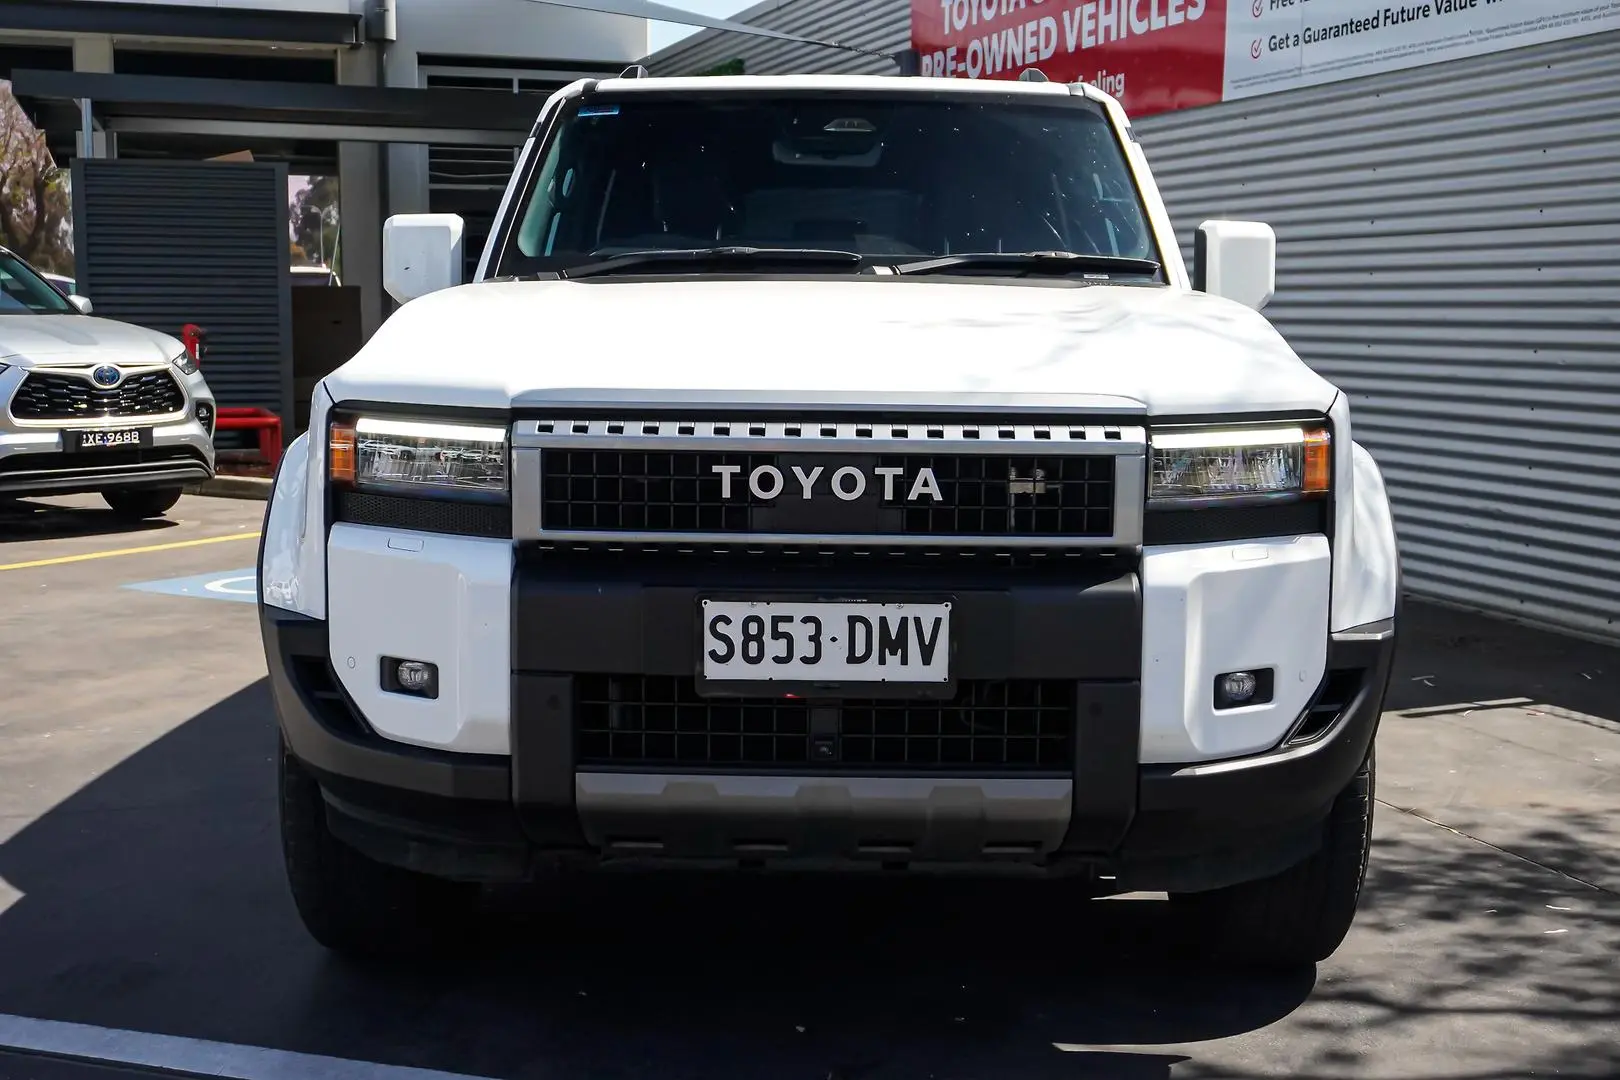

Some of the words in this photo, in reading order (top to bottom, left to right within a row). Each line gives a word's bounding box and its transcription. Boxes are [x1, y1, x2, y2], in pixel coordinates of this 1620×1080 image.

[941, 0, 1026, 35] TOYO
[1268, 33, 1290, 52] Get
[1293, 34, 1300, 47] a
[1303, 10, 1380, 44] Guaranteed
[1383, 4, 1431, 27] Future
[1434, 0, 1477, 15] Value
[922, 16, 1058, 79] PRE-OWNED
[1078, 69, 1125, 97] ling
[711, 464, 943, 501] TOYOTA
